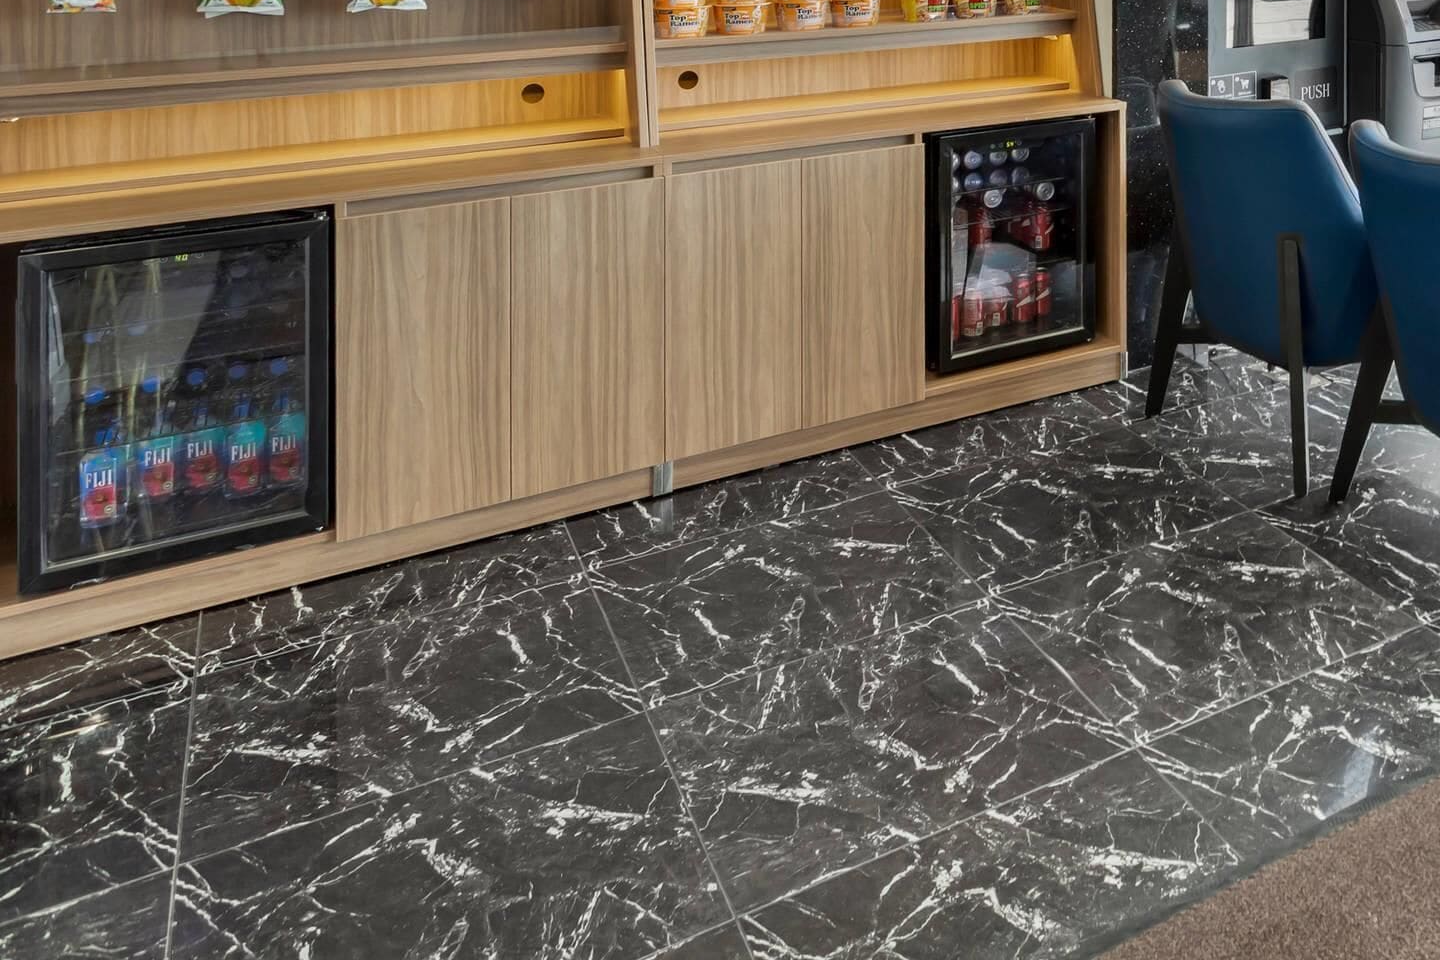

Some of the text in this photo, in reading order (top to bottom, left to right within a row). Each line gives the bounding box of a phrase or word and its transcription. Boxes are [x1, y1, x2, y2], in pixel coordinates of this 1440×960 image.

[1301, 83, 1331, 100] PUSH
[187, 440, 214, 458] FIJI
[231, 442, 257, 461] FIJI
[272, 434, 297, 452] FIJI
[144, 448, 171, 467] FIJI
[86, 469, 112, 489] FIJI
